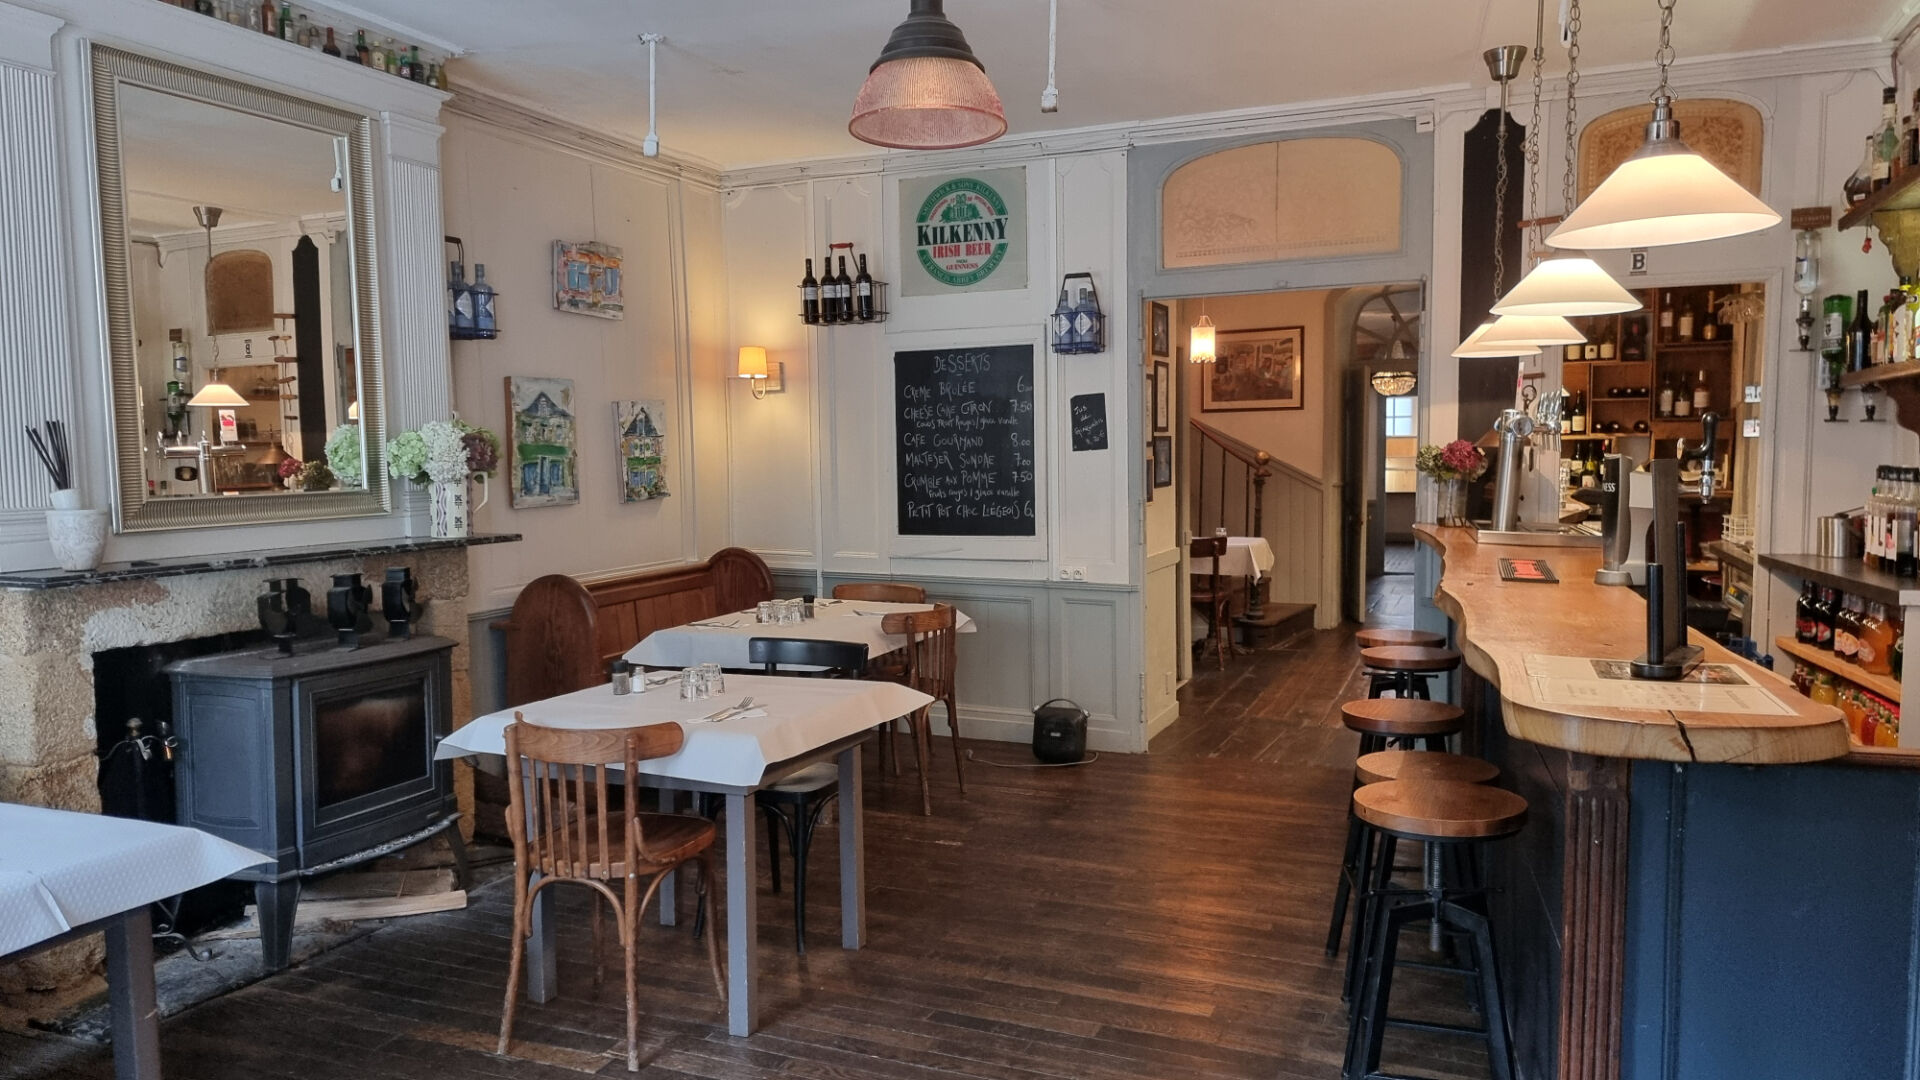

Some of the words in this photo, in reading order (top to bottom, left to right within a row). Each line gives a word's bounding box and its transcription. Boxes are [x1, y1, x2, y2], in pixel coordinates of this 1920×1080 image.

[917, 217, 1008, 246] KILKENNY
[932, 244, 961, 258] IRISH
[965, 242, 991, 257] BEER
[946, 263, 979, 271] GUINNESS
[1632, 253, 1645, 270] B
[933, 353, 991, 373] DESSERTS
[904, 405, 933, 421] CHEESE
[933, 433, 984, 451] GOURMAND
[905, 451, 953, 470] MALTESER
[960, 452, 996, 469] SUNDAE
[904, 473, 943, 493] CRUMBLE
[961, 470, 998, 488] POMME
[907, 501, 934, 519] PETIT
[936, 504, 953, 518] POT
[956, 504, 979, 518] CHOC
